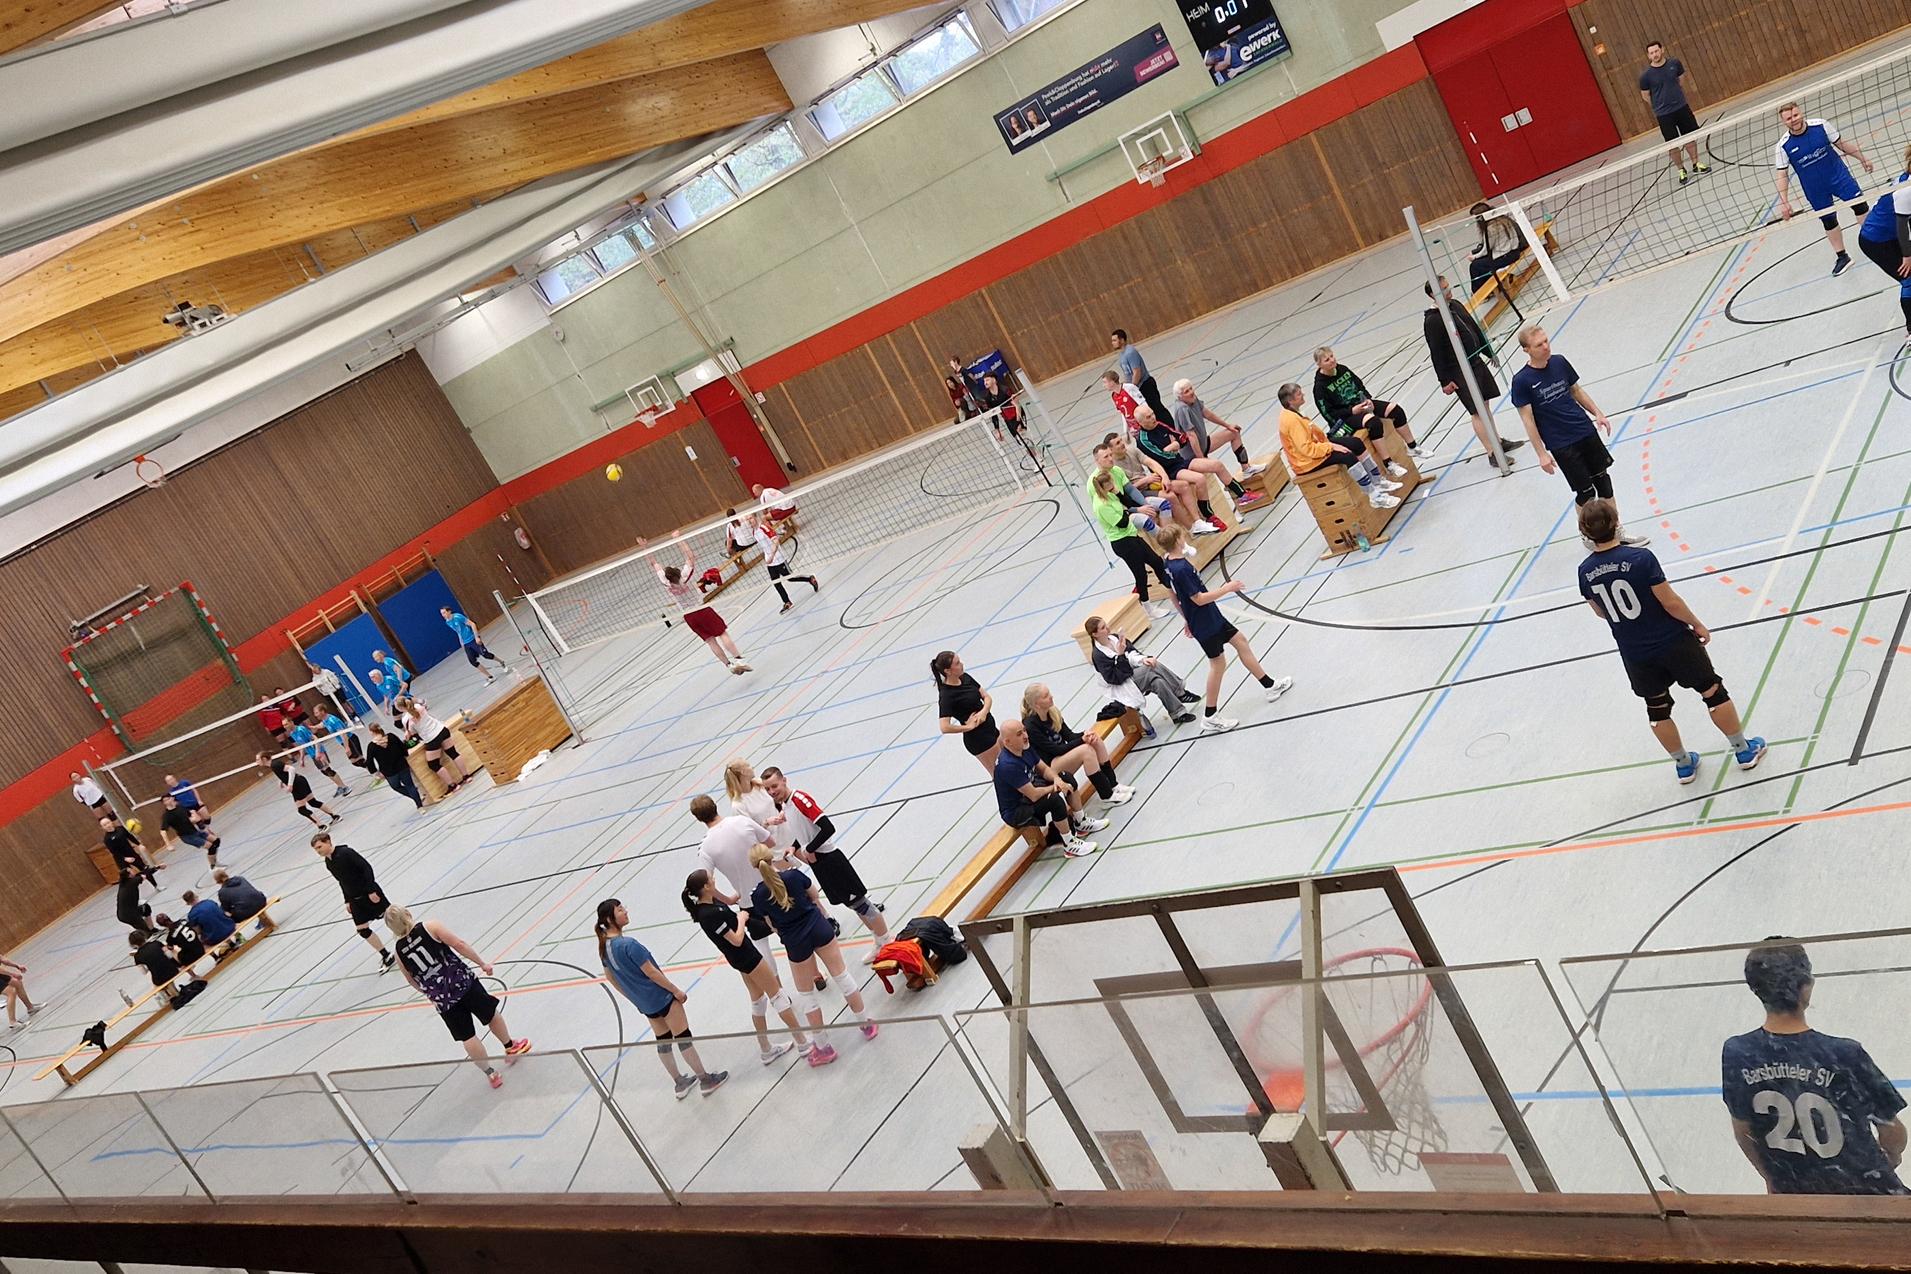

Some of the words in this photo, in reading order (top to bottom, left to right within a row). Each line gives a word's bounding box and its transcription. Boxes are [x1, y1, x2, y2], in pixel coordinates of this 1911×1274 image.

[1186, 2, 1211, 22] HEIM
[1239, 29, 1281, 62] ewerk
[1247, 24, 1270, 41] powered
[1620, 561, 1633, 572] SV
[1590, 579, 1642, 623] 10
[181, 926, 196, 942] 5
[407, 945, 436, 972] 11
[1741, 1062, 1813, 1085] Barsbütteler
[1815, 1067, 1836, 1088] SV
[1752, 1090, 1845, 1159] 20
